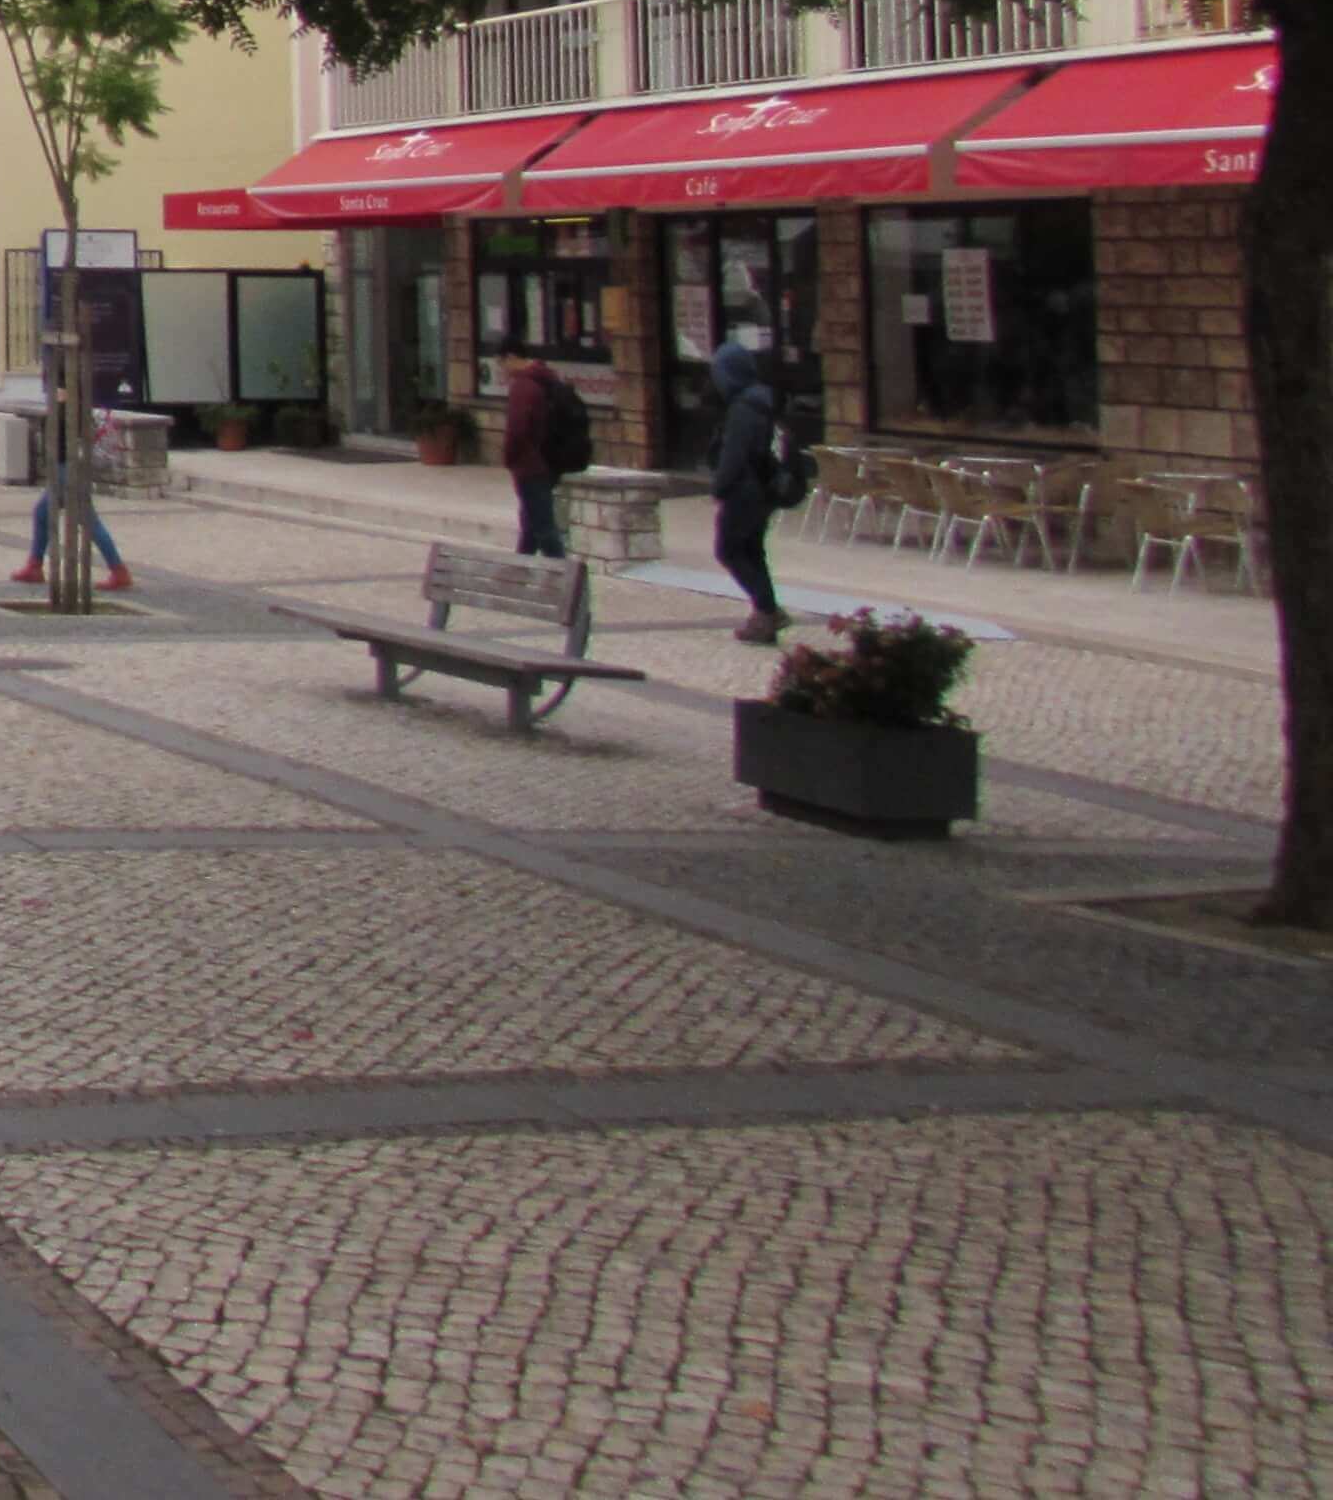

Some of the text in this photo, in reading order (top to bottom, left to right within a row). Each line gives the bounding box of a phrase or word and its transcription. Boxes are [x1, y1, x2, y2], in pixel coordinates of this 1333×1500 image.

[1204, 148, 1259, 173] Sant
[685, 175, 719, 197] Café
[196, 201, 241, 216] Restaurante
[339, 193, 389, 211] Santa Cruz
